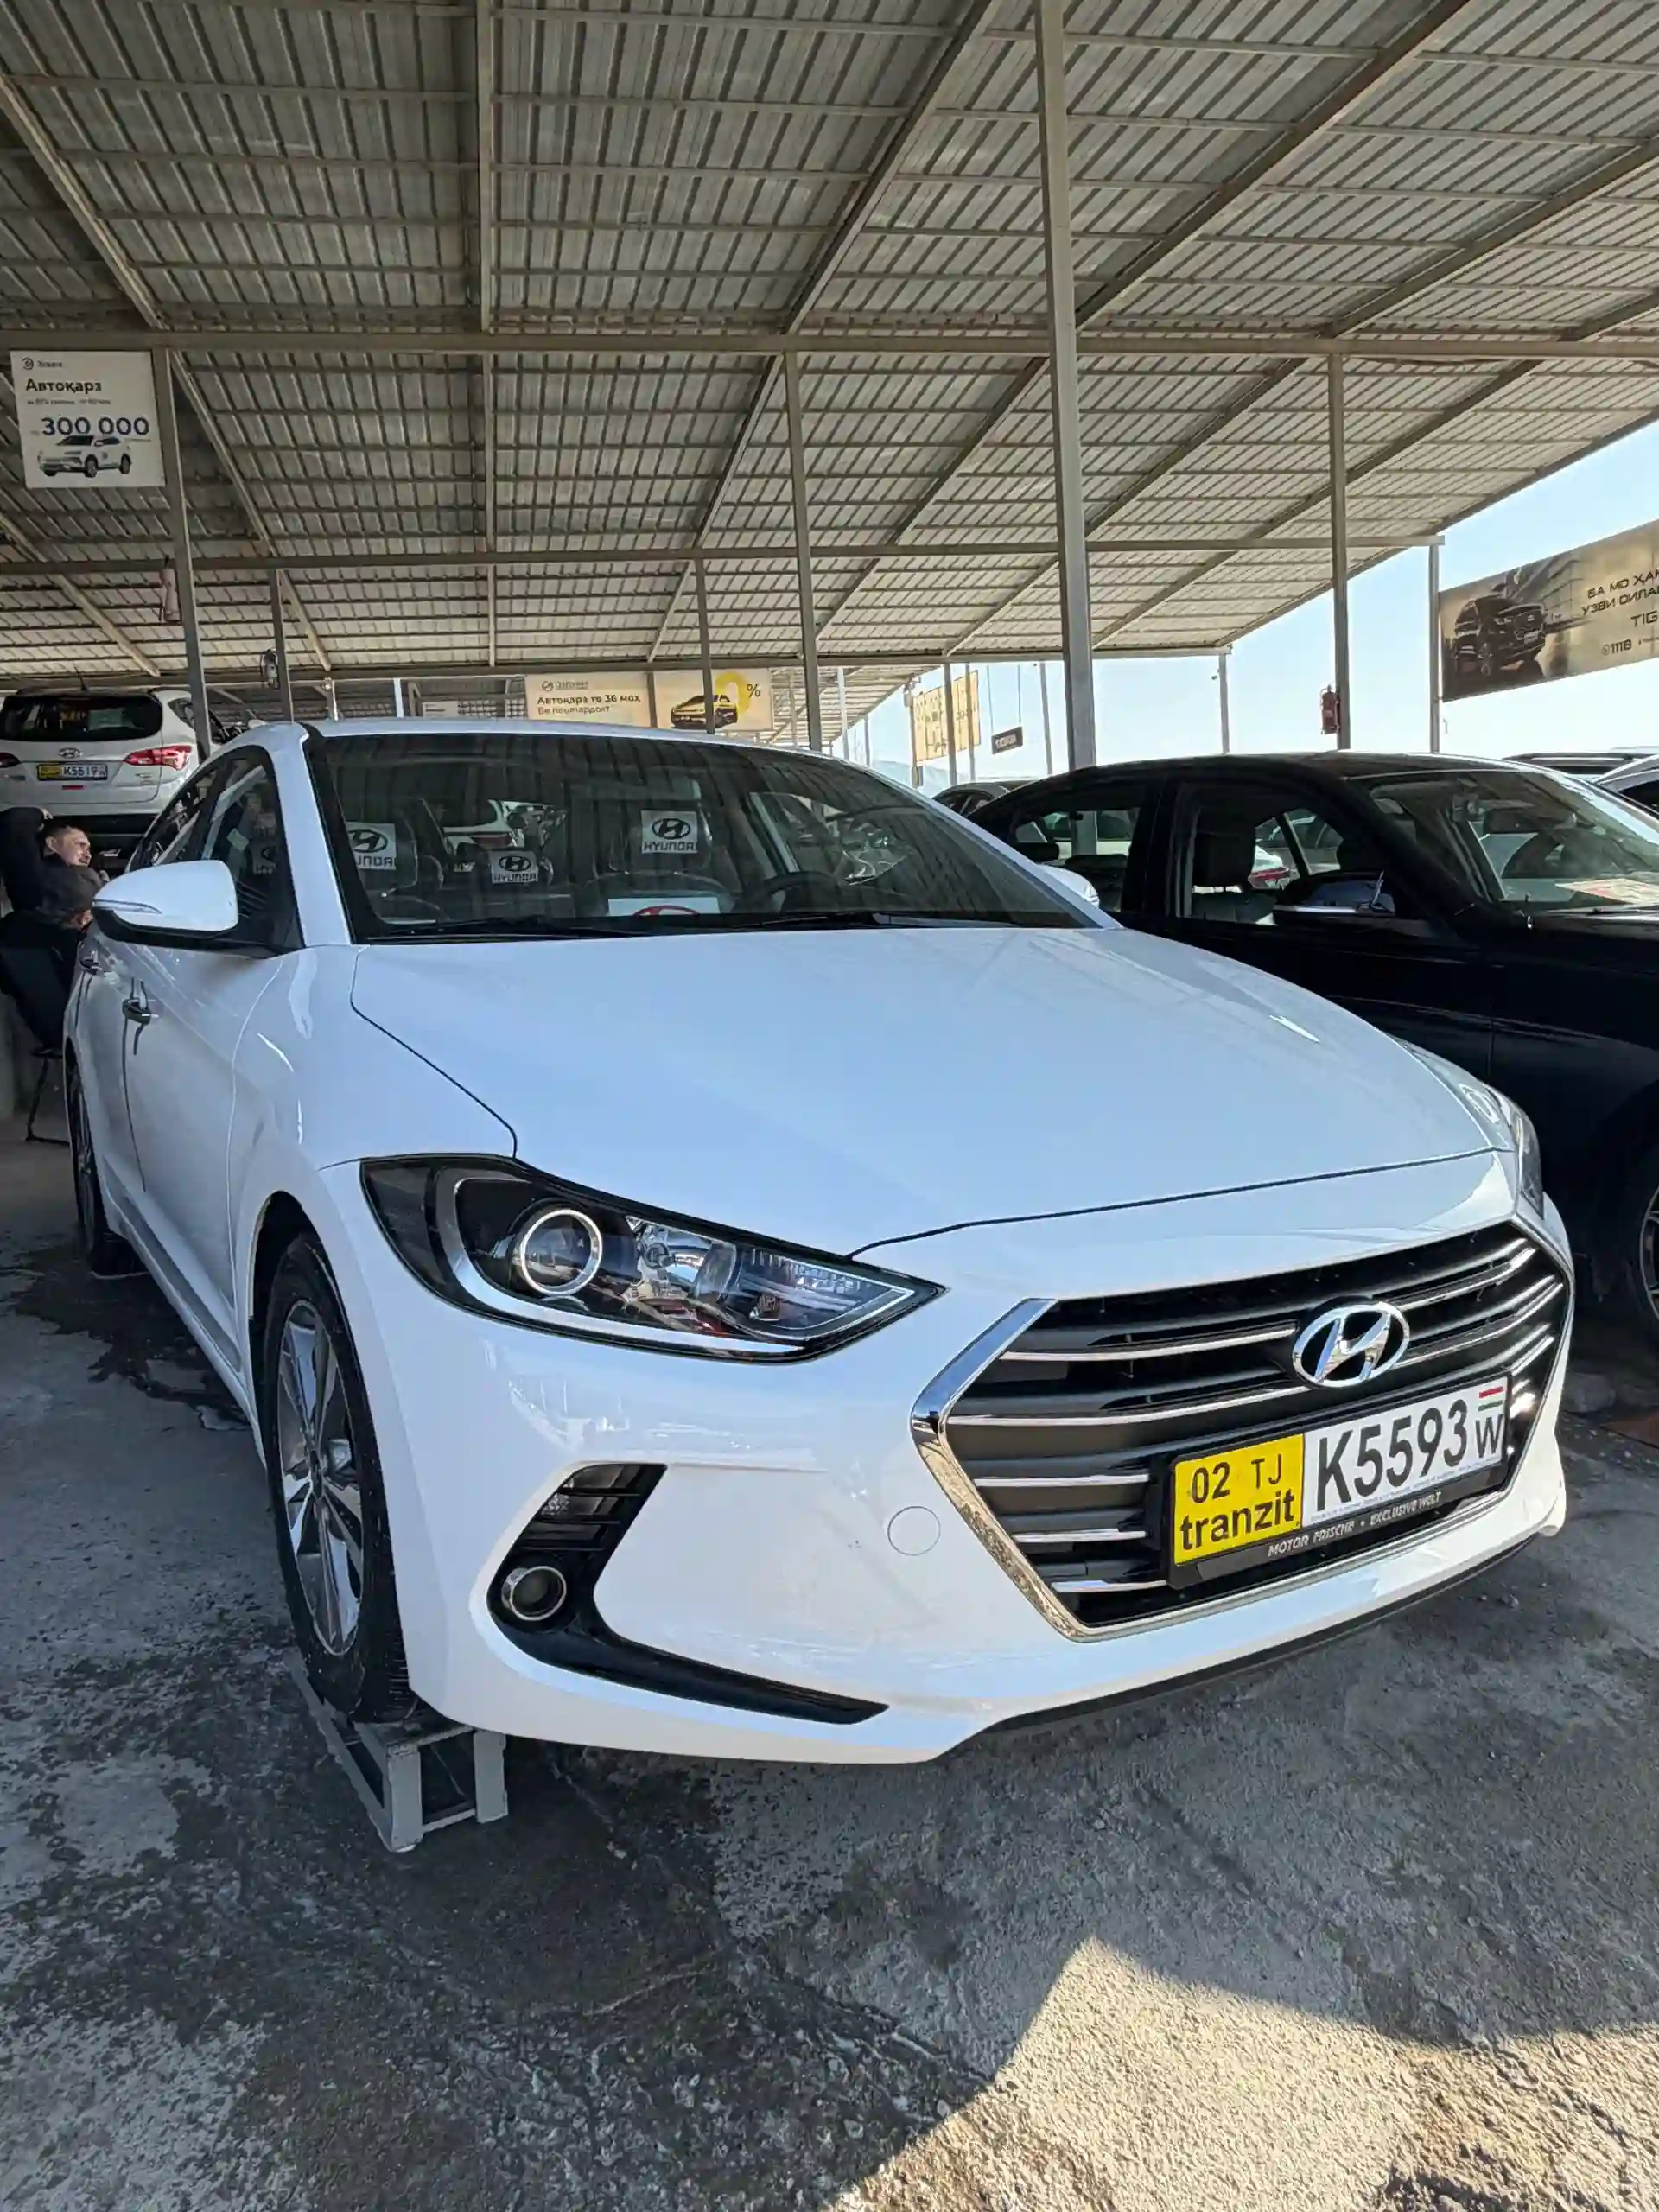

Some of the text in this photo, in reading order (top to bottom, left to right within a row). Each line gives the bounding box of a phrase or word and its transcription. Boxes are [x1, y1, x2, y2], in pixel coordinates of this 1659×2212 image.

[26, 378, 102, 394] Автоқарз
[41, 416, 149, 435] 300 000
[1619, 585, 1659, 606] ОИЛА
[1192, 1453, 1282, 1504] 02 TJ
[1179, 1488, 1295, 1550] tranzit
[1268, 1534, 1309, 1557] MOTOR
[1370, 1498, 1416, 1526] EXCLUSIVE
[1418, 1491, 1442, 1510] WELT
